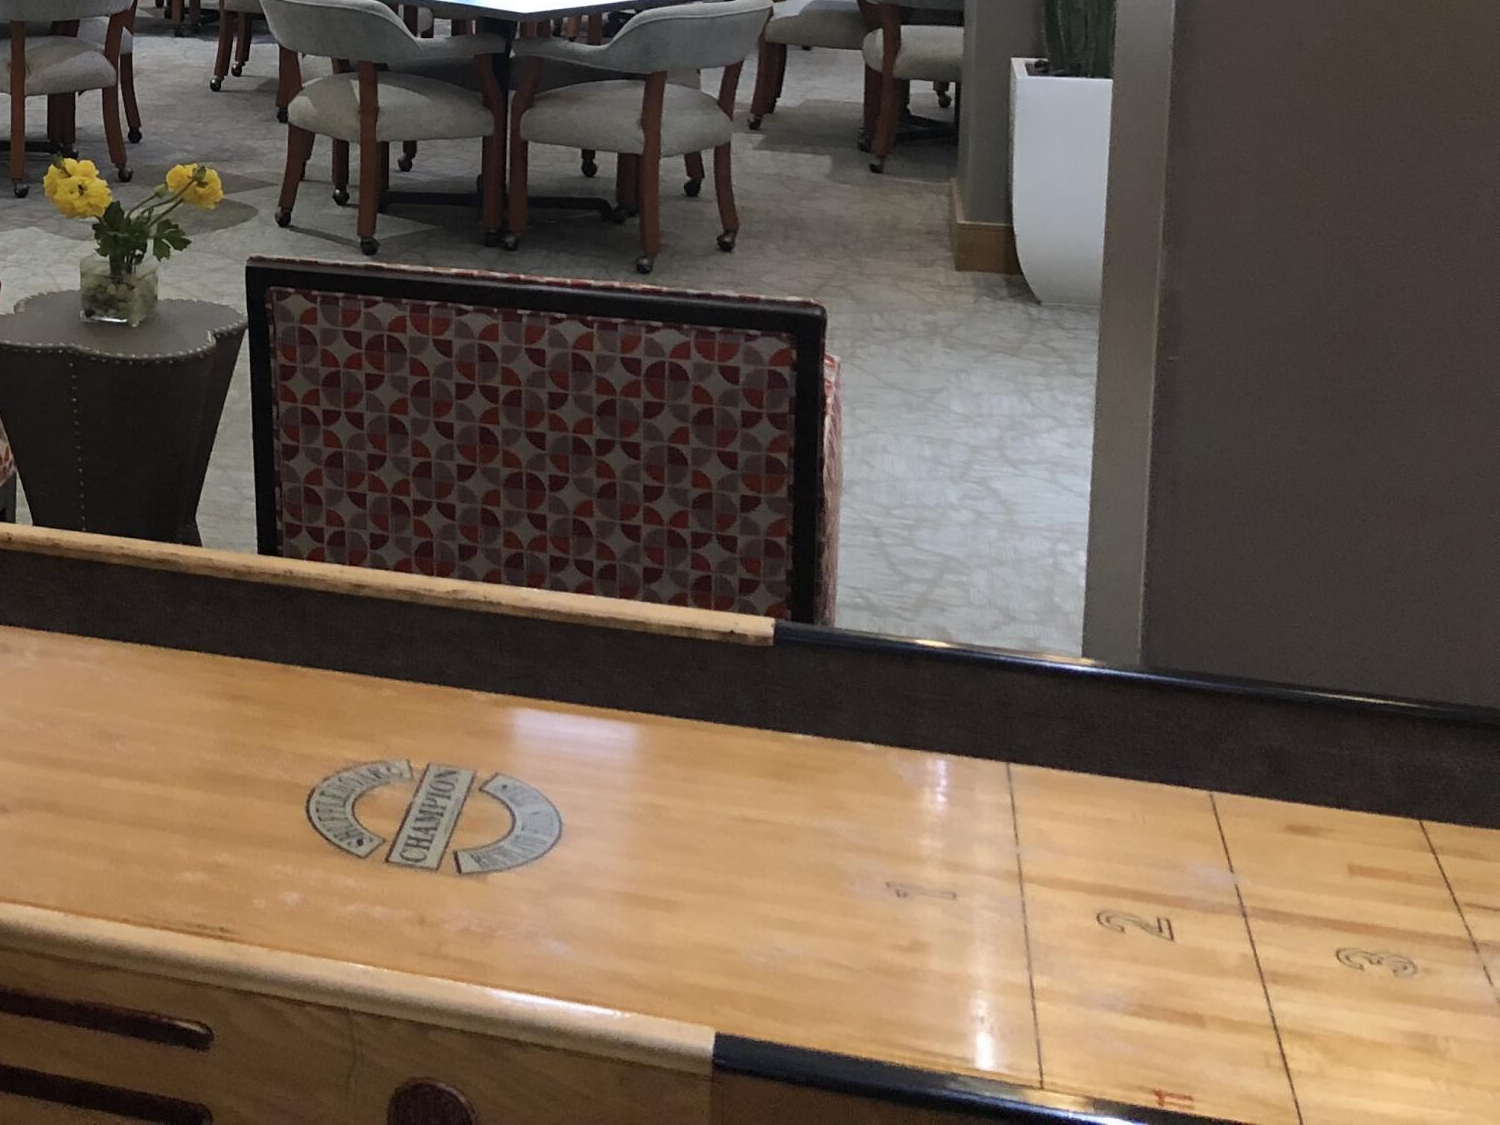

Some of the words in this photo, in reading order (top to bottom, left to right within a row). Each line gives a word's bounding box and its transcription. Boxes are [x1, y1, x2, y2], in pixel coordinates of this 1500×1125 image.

[399, 769, 458, 864] CHAMPION
[1096, 909, 1175, 942] 2
[1336, 947, 1418, 977] 3
